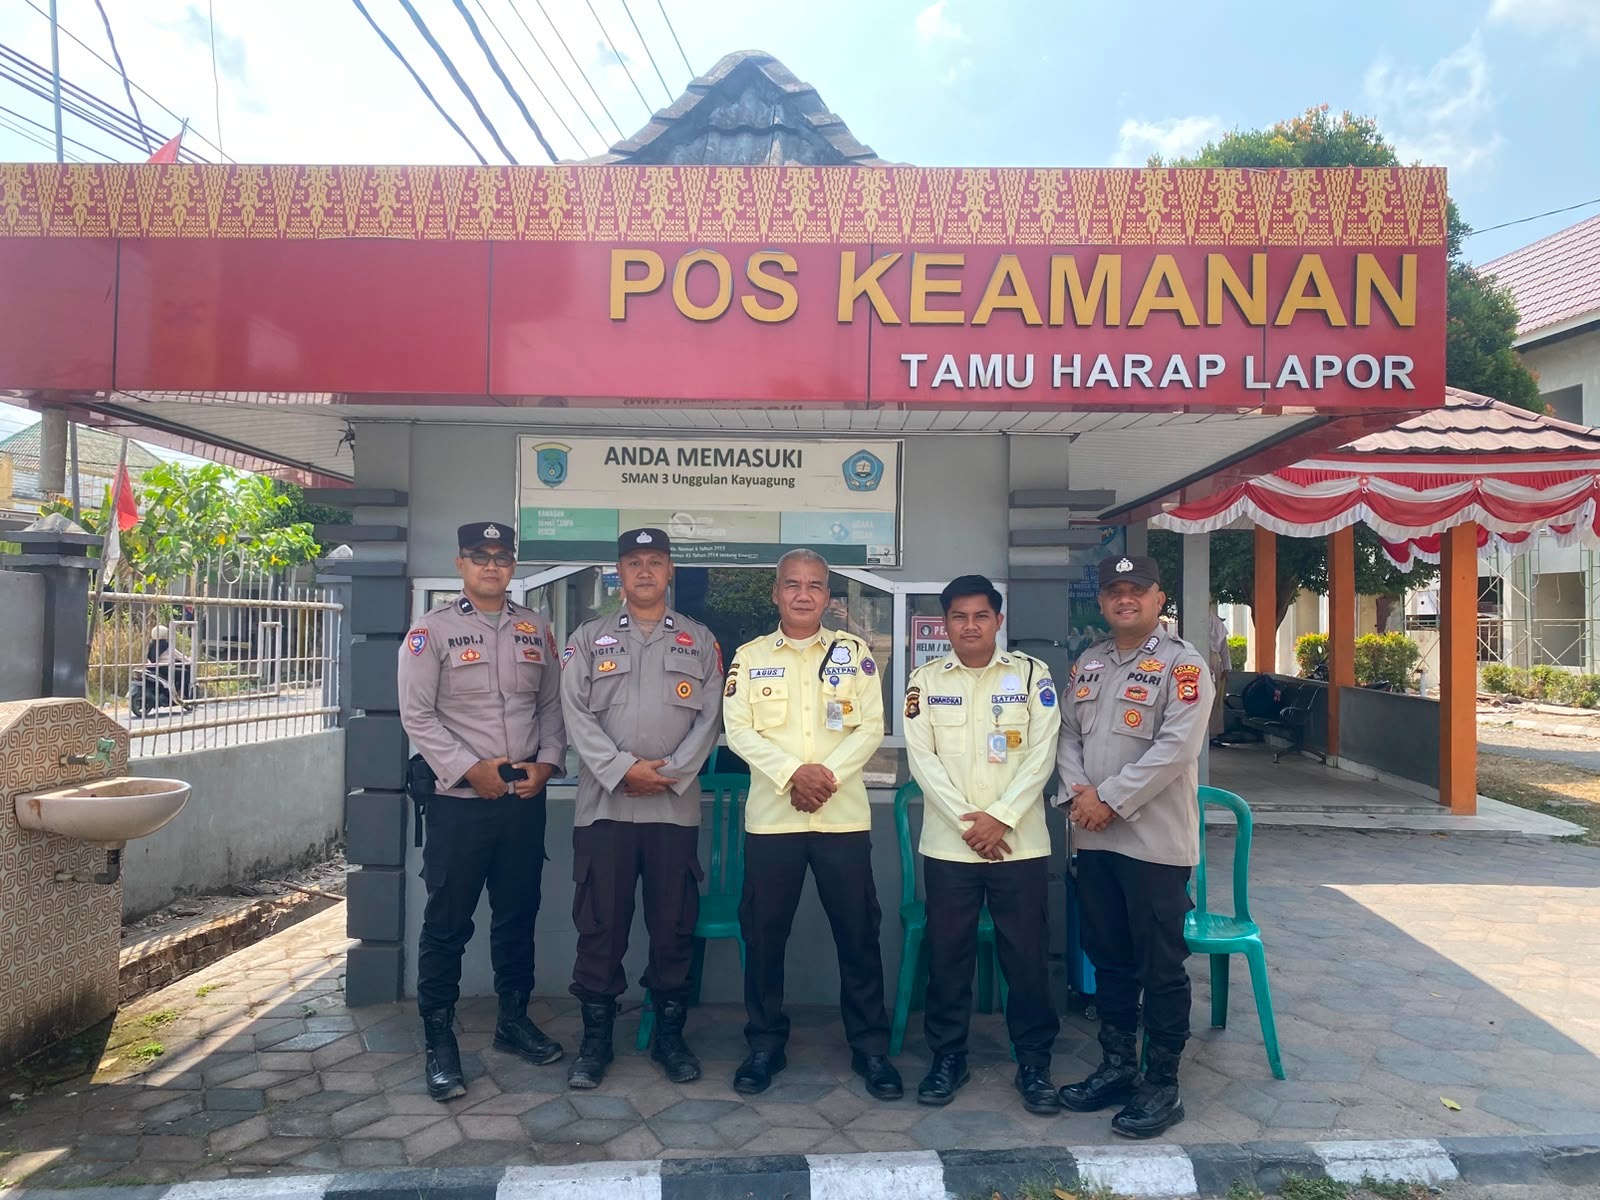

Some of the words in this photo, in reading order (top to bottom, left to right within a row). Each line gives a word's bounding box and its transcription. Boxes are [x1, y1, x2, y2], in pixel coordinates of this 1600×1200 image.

[609, 248, 799, 323] POS
[836, 250, 1418, 327] KEAMANAN
[900, 352, 1035, 389] TAMU
[1052, 353, 1226, 390] HARAP
[1245, 354, 1416, 390] LAPOR
[604, 446, 670, 467] ANDA
[677, 448, 802, 469] MEMASUKI
[621, 472, 658, 484] SMAN
[661, 473, 669, 484] 3
[672, 473, 728, 487] Unggulan
[731, 474, 796, 489] Kayuagung
[448, 634, 484, 648] RUDI.J
[514, 634, 543, 647] POLRI
[916, 643, 935, 652] HELM
[670, 646, 700, 657] POLRI
[1077, 674, 1100, 684] AJI
[1127, 672, 1162, 686] POLRI
